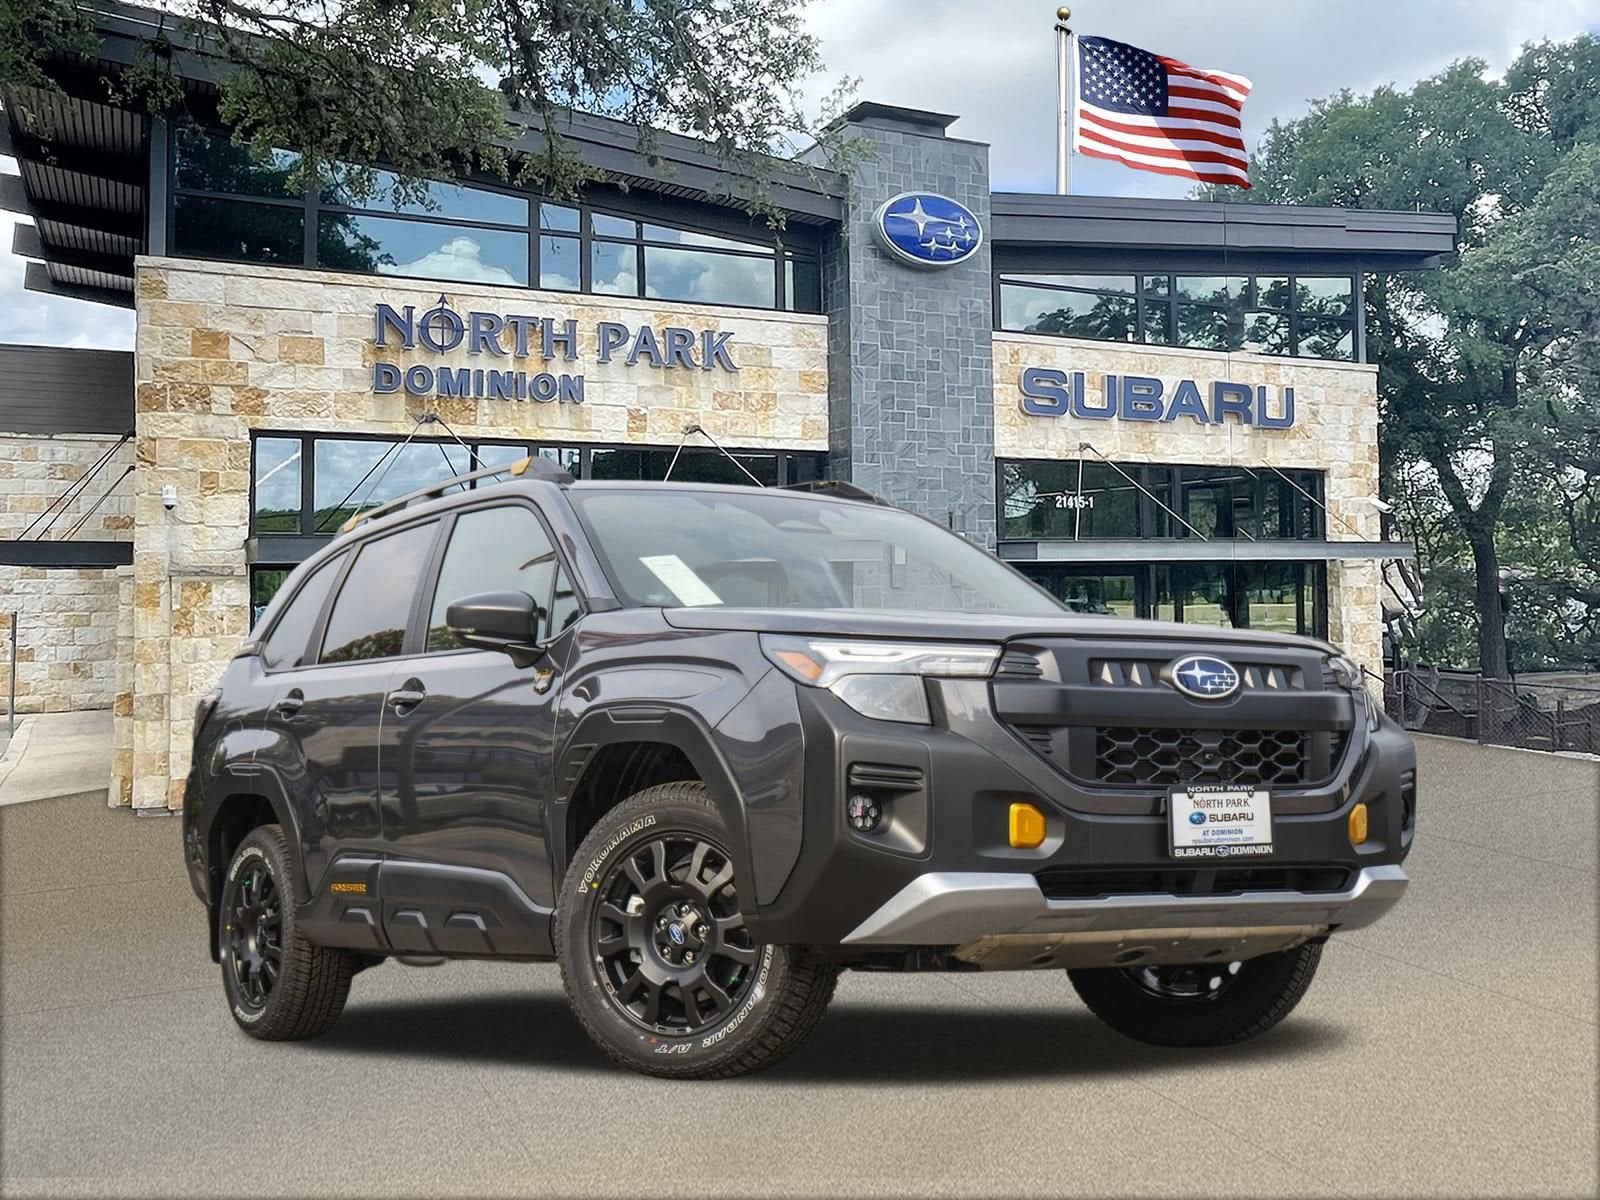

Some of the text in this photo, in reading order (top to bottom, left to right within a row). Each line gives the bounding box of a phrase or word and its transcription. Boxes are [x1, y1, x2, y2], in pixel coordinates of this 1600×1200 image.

[375, 301, 740, 373] NORTH PARK
[373, 362, 585, 404] DOMINION
[1019, 367, 1296, 430] SUBARU
[1055, 496, 1094, 509] 21415-1
[1193, 798, 1250, 809] NORTH PARK
[1209, 812, 1254, 823] SUBARU
[1211, 828, 1244, 836] DOMINION
[578, 814, 657, 895] YOKOHAMA
[1174, 845, 1273, 857] SUBARU DOMINION
[655, 1042, 692, 1055] A/T
